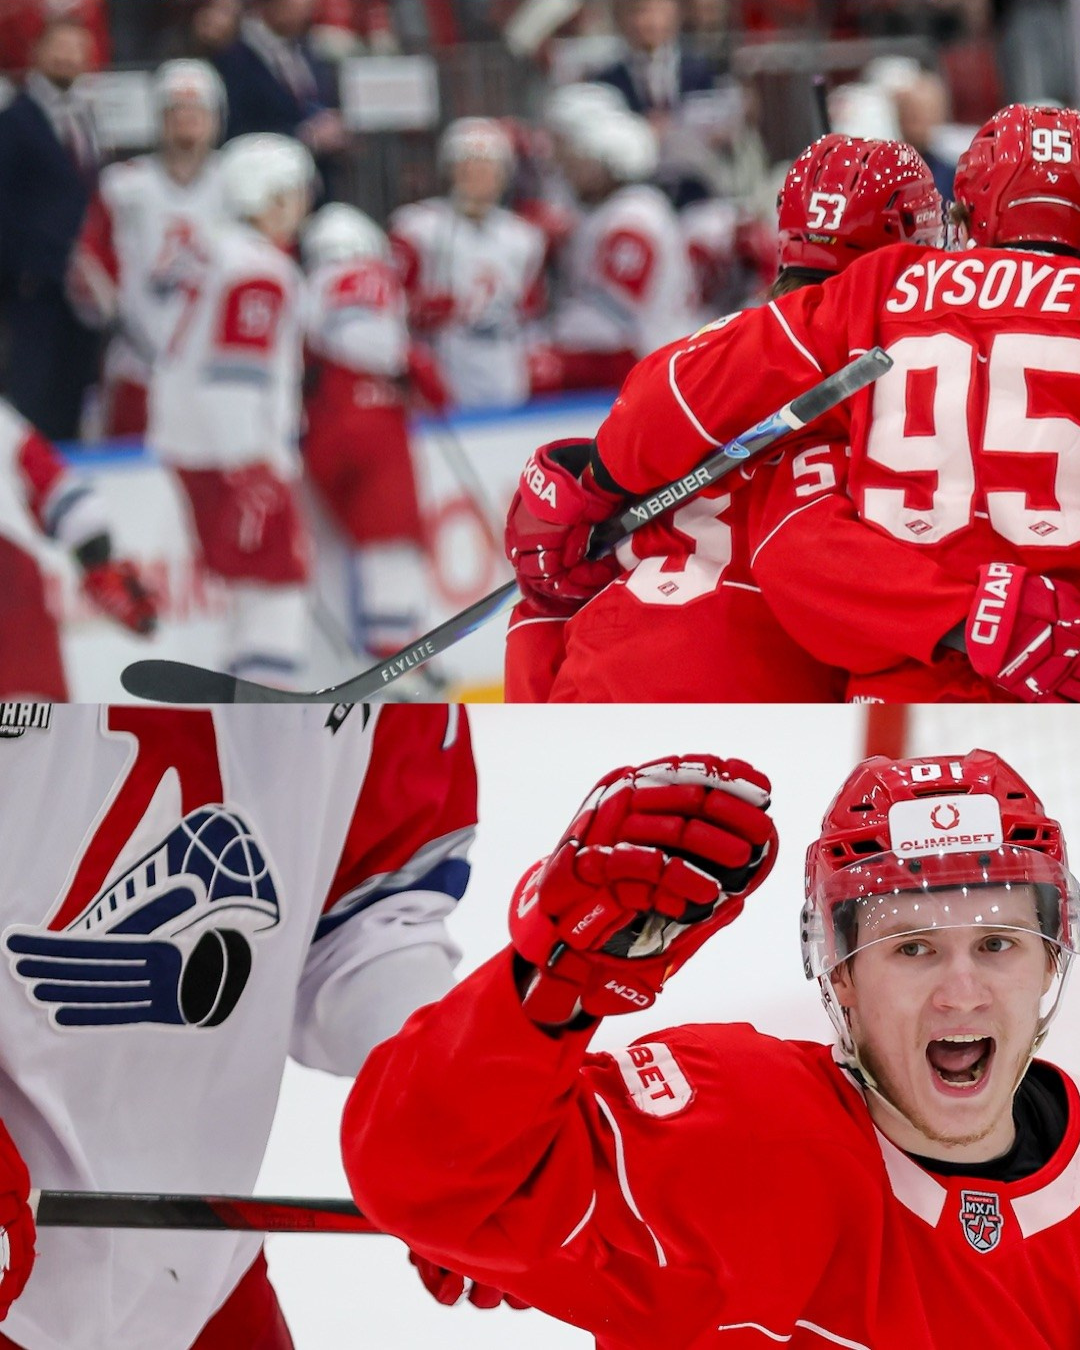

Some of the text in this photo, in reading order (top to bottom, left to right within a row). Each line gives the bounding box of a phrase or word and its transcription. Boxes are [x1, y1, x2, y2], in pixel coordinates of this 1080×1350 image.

[1032, 128, 1072, 164] 95
[806, 191, 847, 230] 53
[916, 211, 936, 223] CCM
[523, 457, 557, 509] КВА
[647, 467, 713, 515] BAUER
[971, 562, 1013, 645] СПАР
[381, 641, 435, 682] FLYLITE
[901, 834, 994, 851] OLIMPBET
[604, 980, 649, 1006] CCM
[966, 1202, 995, 1215] МХЛ
